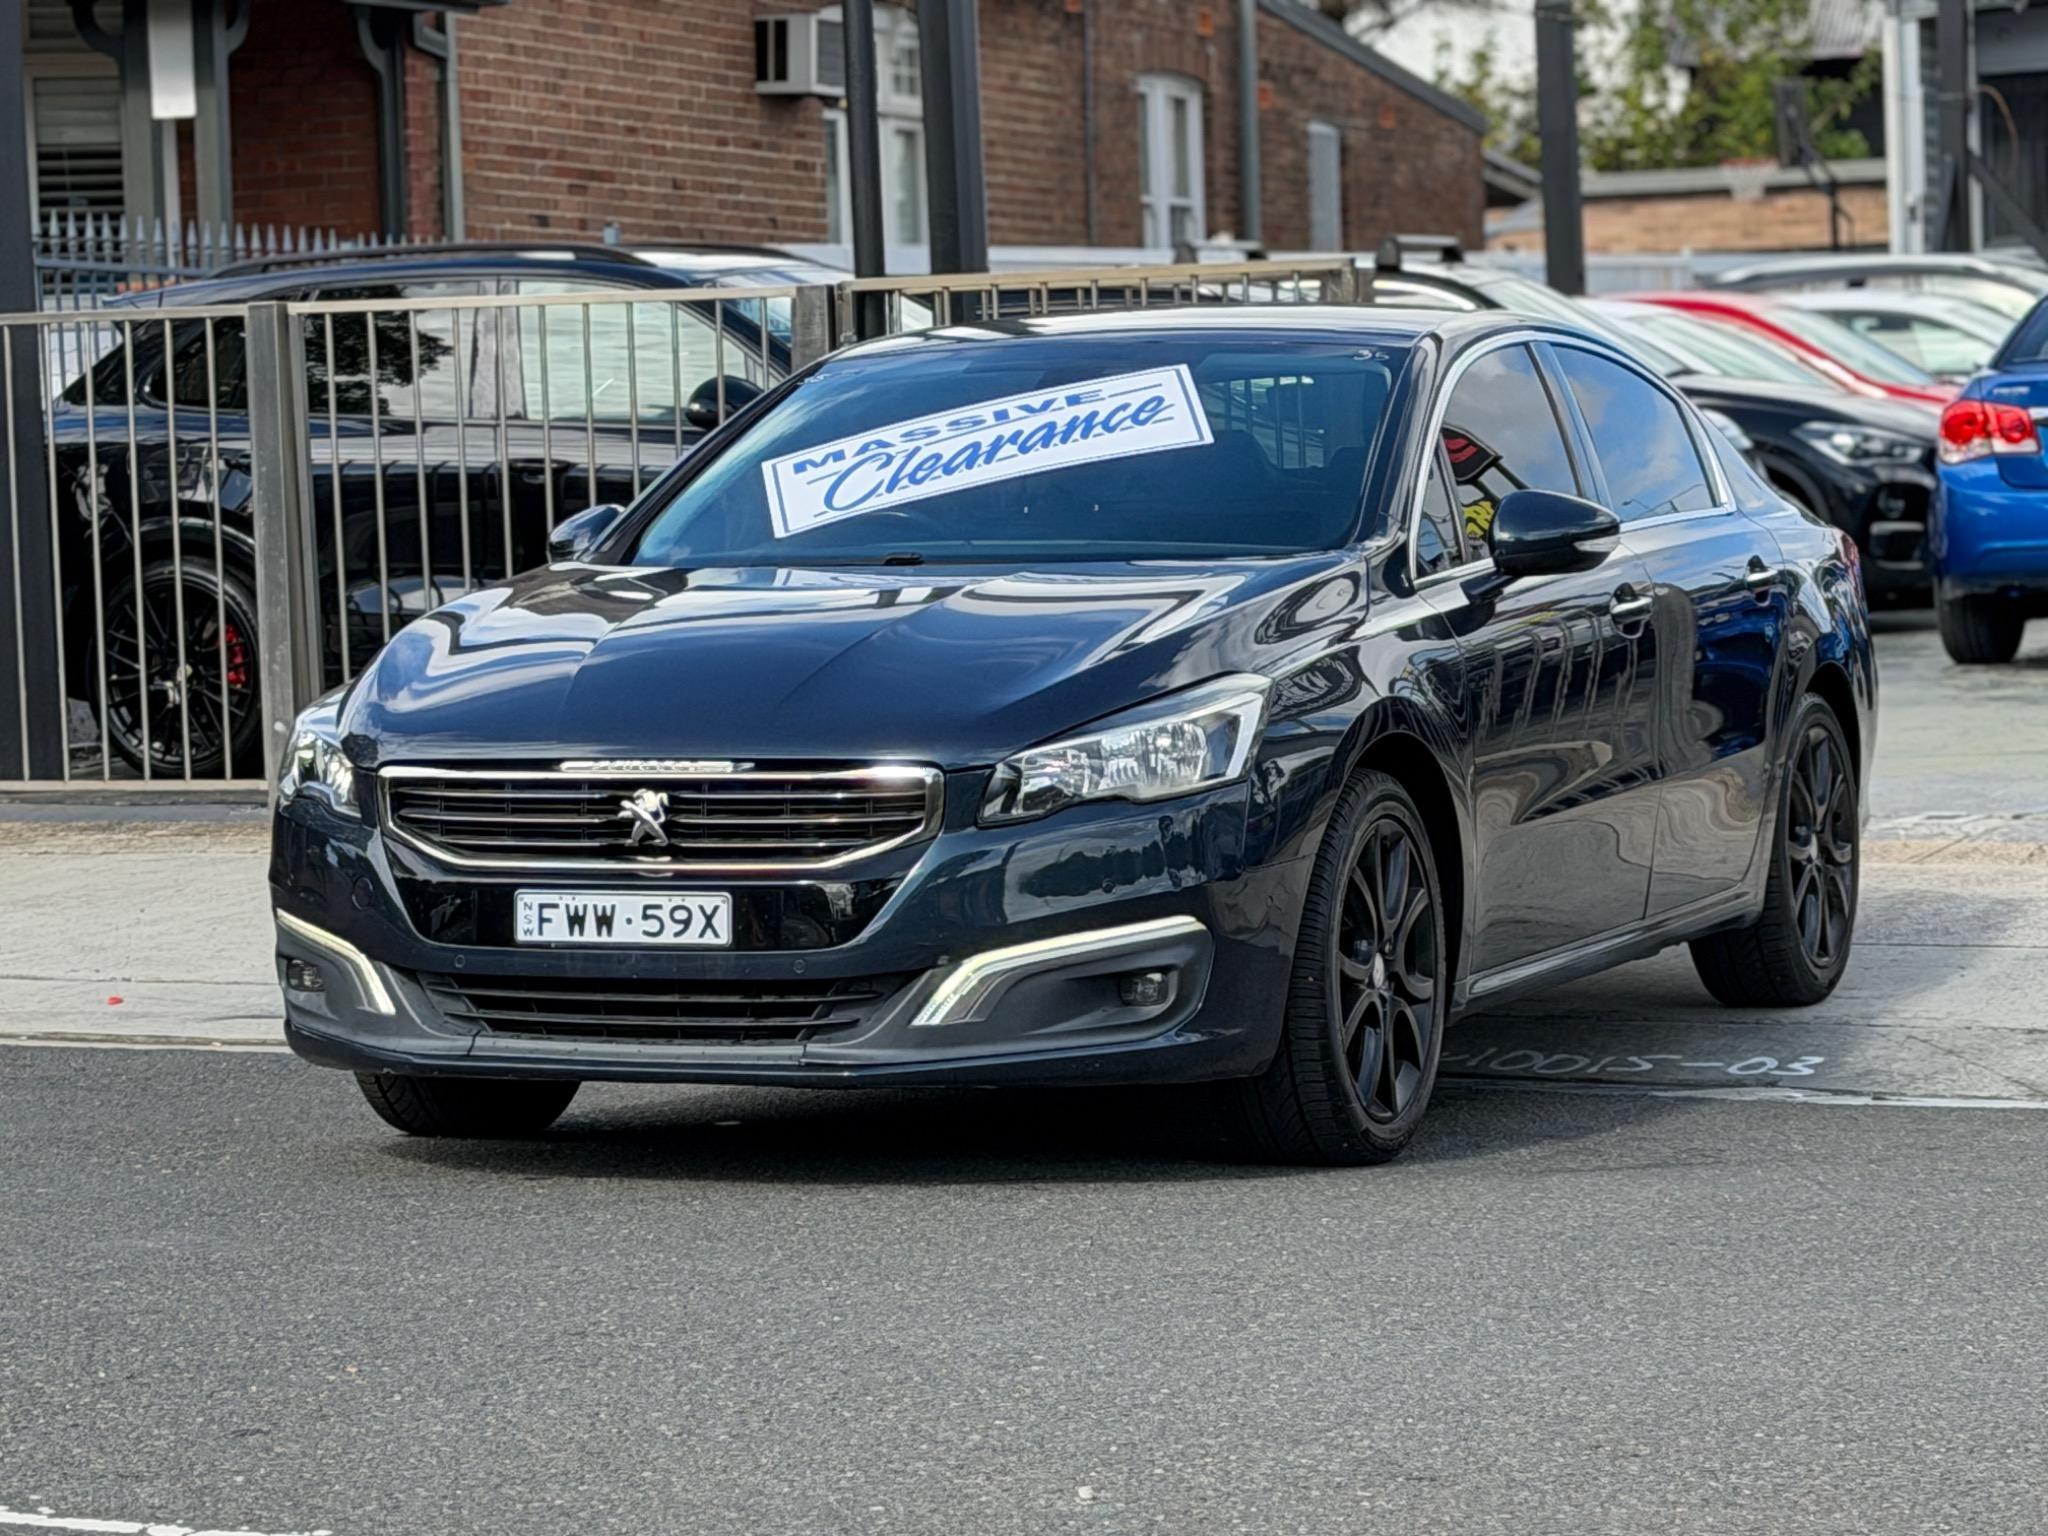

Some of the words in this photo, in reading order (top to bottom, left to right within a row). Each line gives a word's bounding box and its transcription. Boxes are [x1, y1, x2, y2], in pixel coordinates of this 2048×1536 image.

[793, 389, 1106, 475] MASSIVE
[823, 395, 1176, 512] Clearance
[522, 901, 534, 937] NSW
